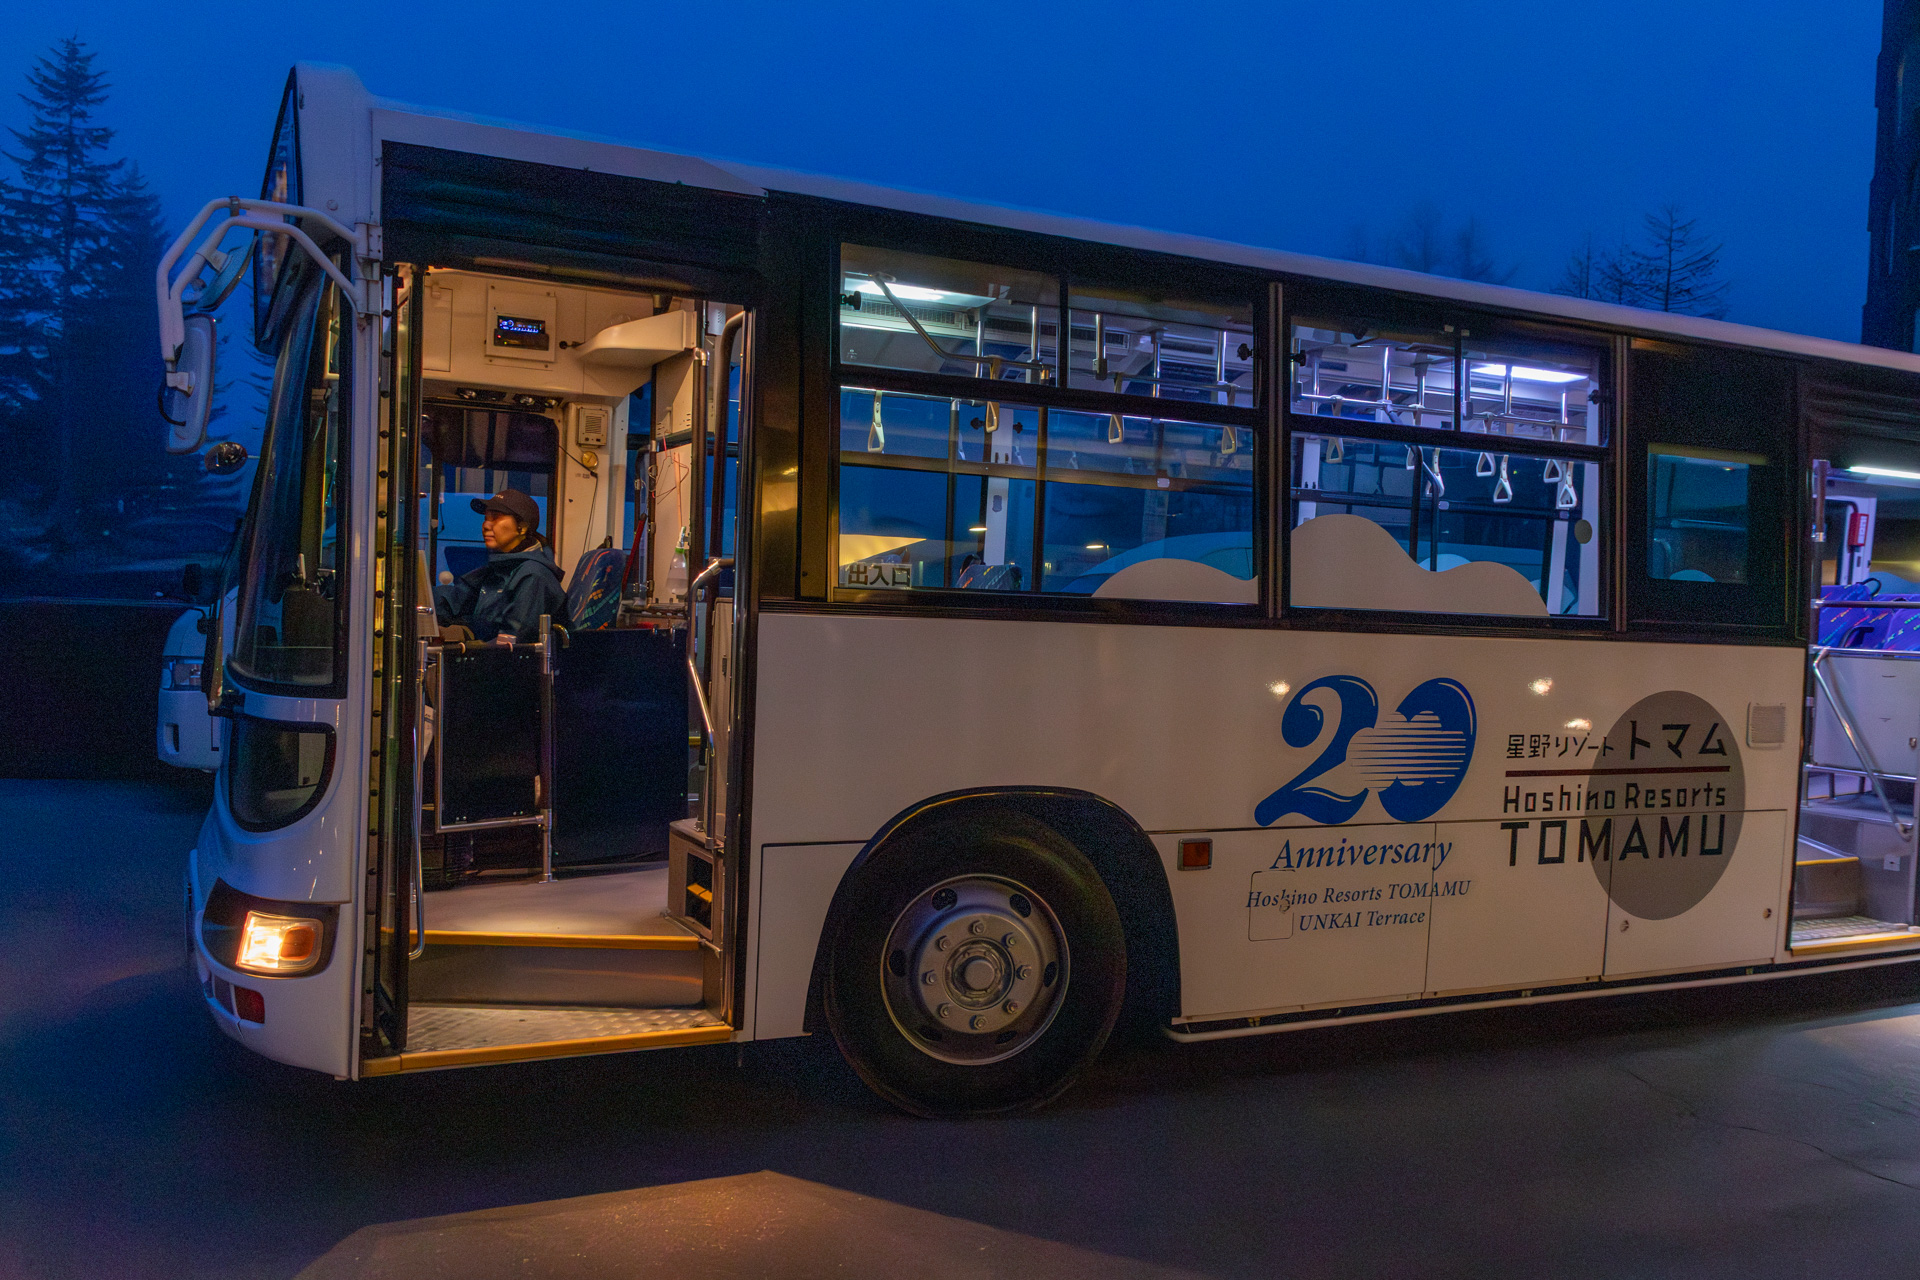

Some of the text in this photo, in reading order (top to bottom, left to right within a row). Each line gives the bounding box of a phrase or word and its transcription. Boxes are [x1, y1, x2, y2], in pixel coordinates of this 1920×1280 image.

[848, 564, 910, 586] 出入口
[1254, 674, 1477, 827] 20
[1506, 720, 1727, 760] 星野リゾート トマム
[1503, 782, 1726, 813] Hoshino Resorts
[1269, 838, 1453, 871] Anniversary
[1500, 814, 1726, 867] TOMAMU
[1323, 887, 1382, 904] Resorts
[1388, 880, 1472, 900] TOMAMU
[1299, 911, 1425, 931] UNKAI Terrace
